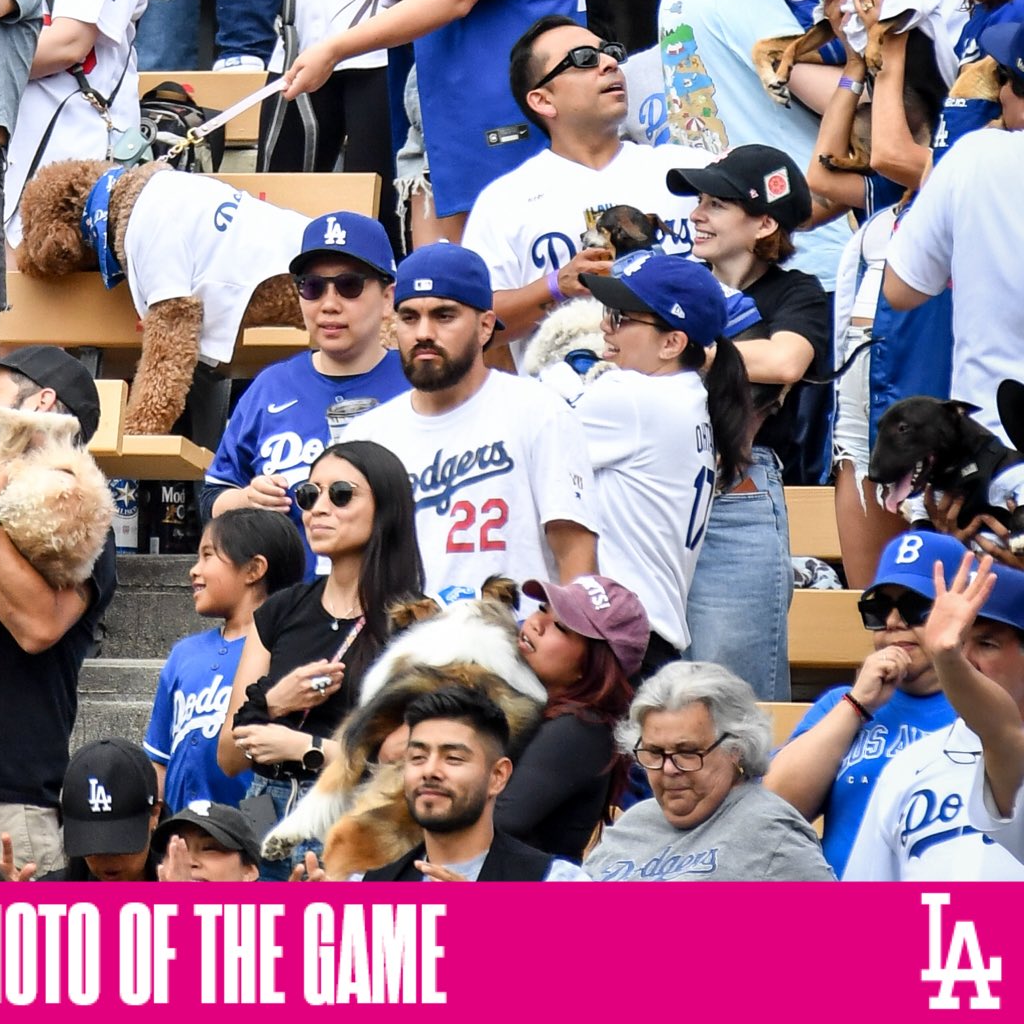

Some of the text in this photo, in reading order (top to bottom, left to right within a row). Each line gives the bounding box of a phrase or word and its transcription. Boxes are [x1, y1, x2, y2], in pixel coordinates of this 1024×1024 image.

[323, 216, 347, 245] LA
[446, 498, 509, 553] 22
[895, 534, 924, 564] B
[88, 778, 112, 813] LA
[601, 845, 720, 882] Ddgers
